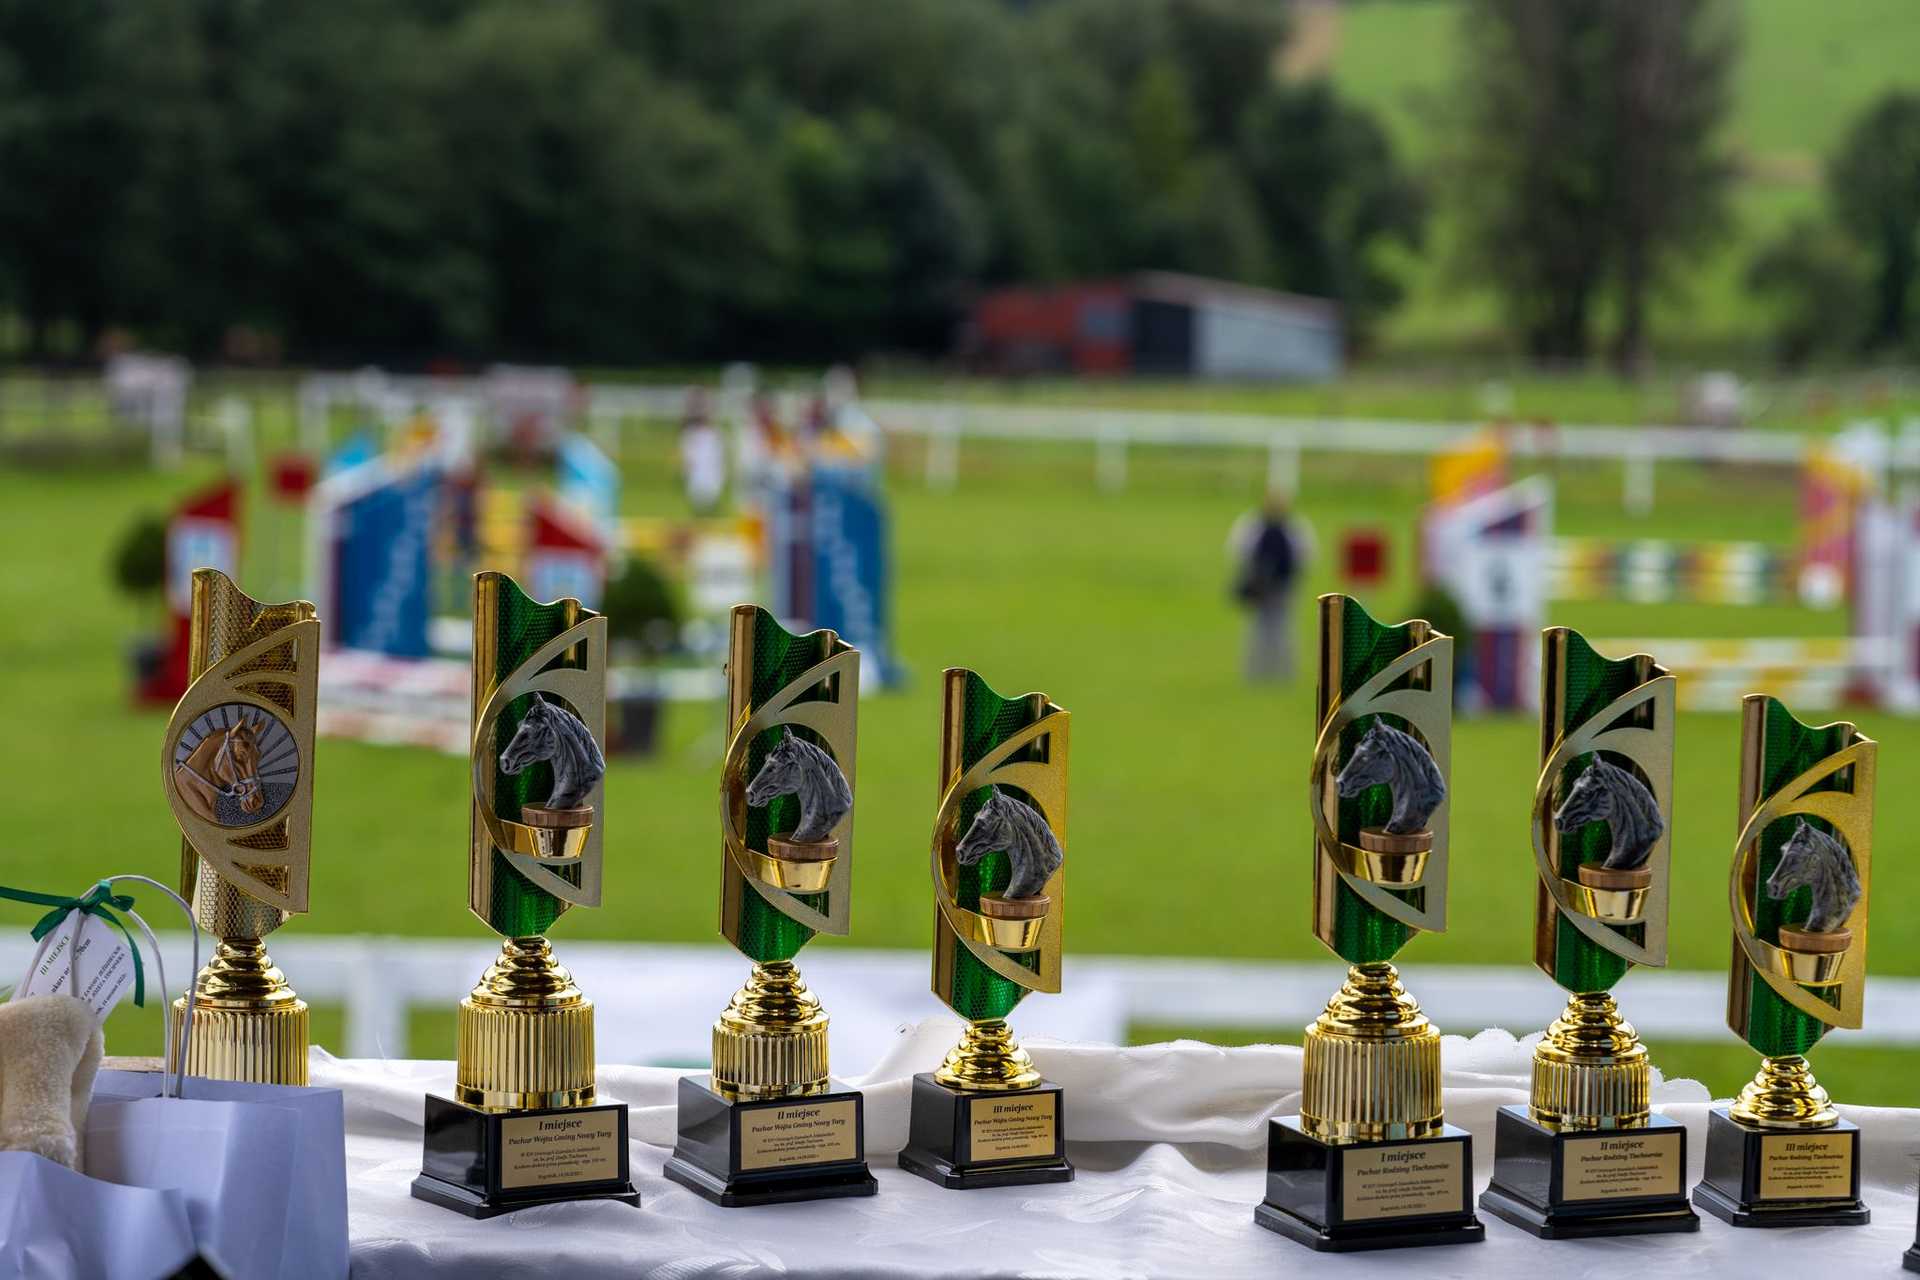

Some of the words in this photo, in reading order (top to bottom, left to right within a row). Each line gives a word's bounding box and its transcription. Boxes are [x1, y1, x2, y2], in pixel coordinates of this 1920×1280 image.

[786, 1109, 821, 1120] miejsce
[1004, 1104, 1034, 1114] miejsce
[544, 1119, 583, 1132] miejsce
[752, 1125, 773, 1133] Puchar
[832, 1118, 846, 1126] Targ
[508, 1136, 532, 1145] Puchar
[596, 1130, 612, 1139] Targ
[1609, 1140, 1644, 1152] miejsce
[1797, 1142, 1829, 1152] miejsce
[1387, 1151, 1426, 1163] miejsce
